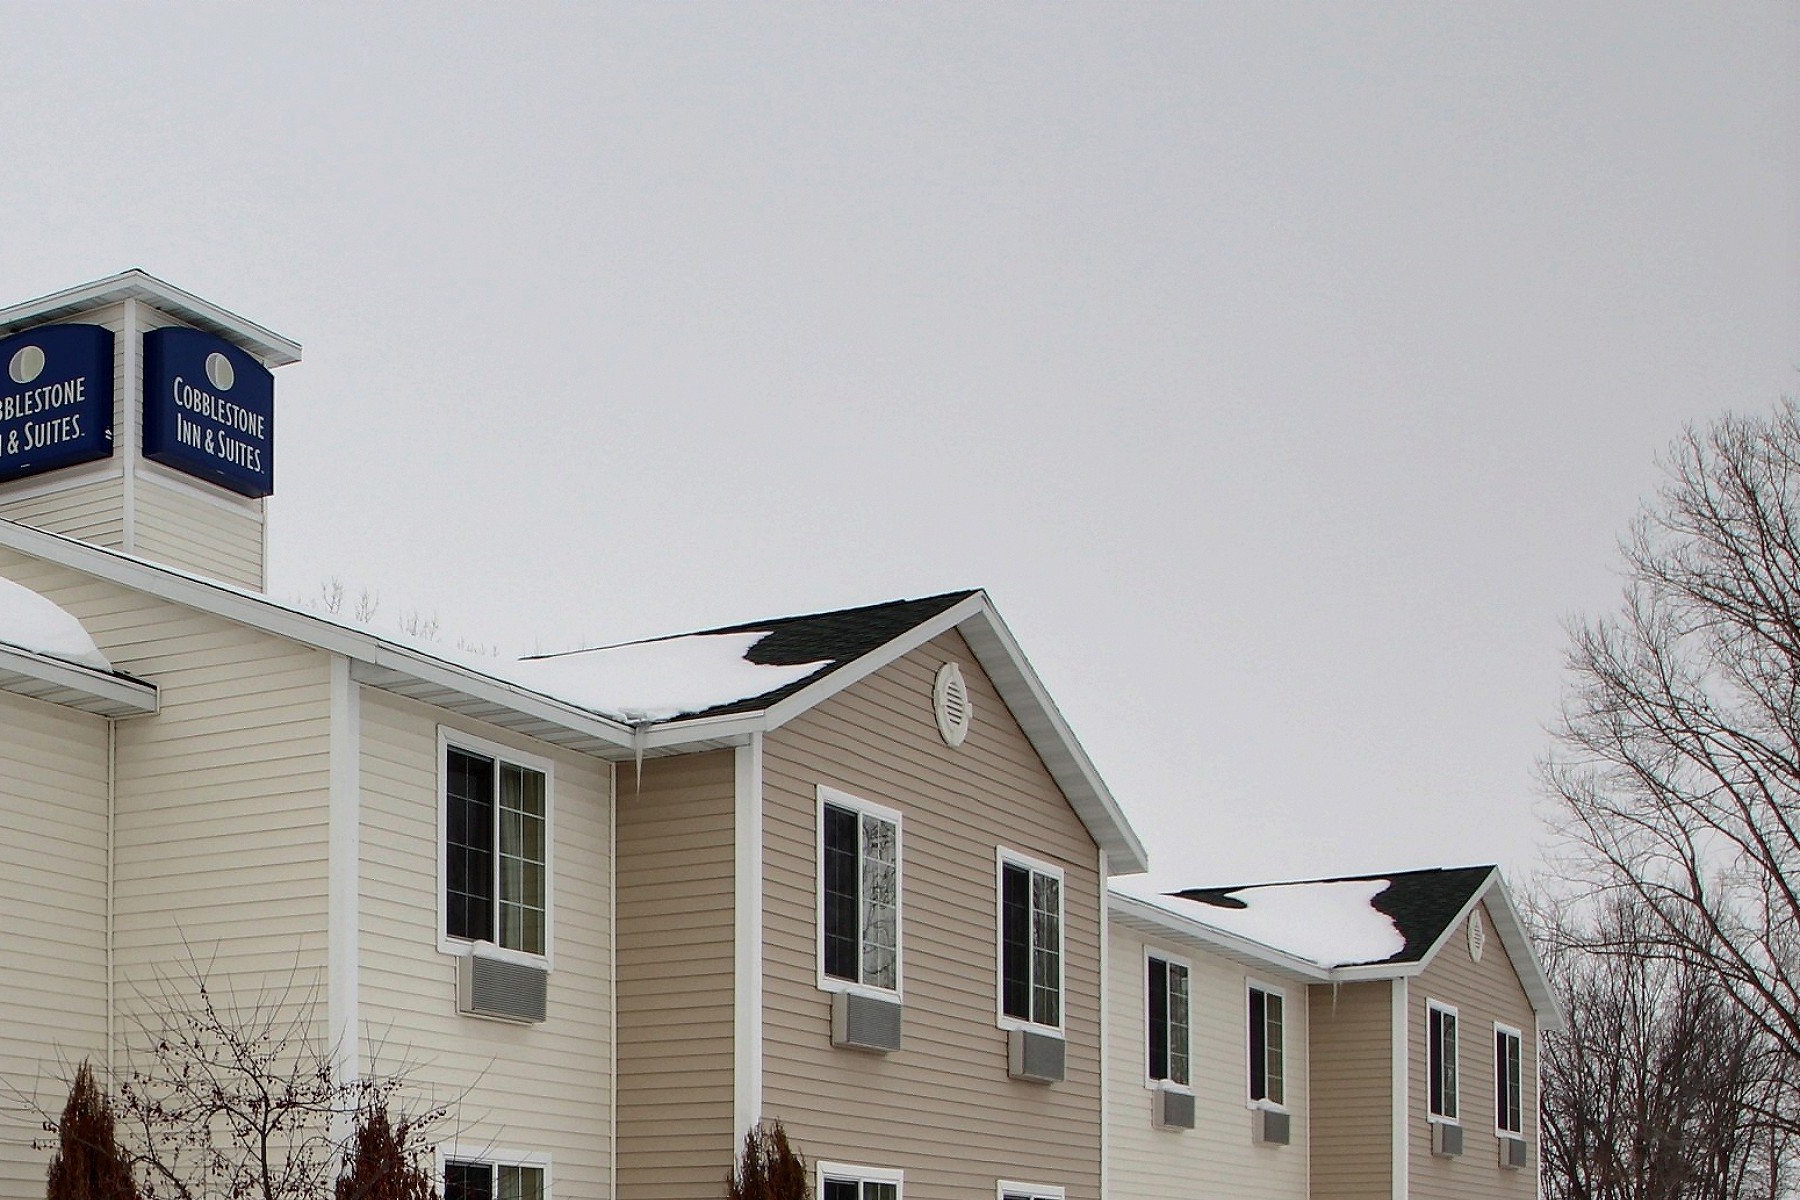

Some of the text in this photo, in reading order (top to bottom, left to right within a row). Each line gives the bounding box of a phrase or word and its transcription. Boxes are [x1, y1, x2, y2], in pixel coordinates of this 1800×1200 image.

[7, 429, 19, 455] &
[23, 414, 81, 451] SUITES
[173, 376, 265, 440] COBBLESTONE
[177, 412, 261, 472] INN & SUITES
